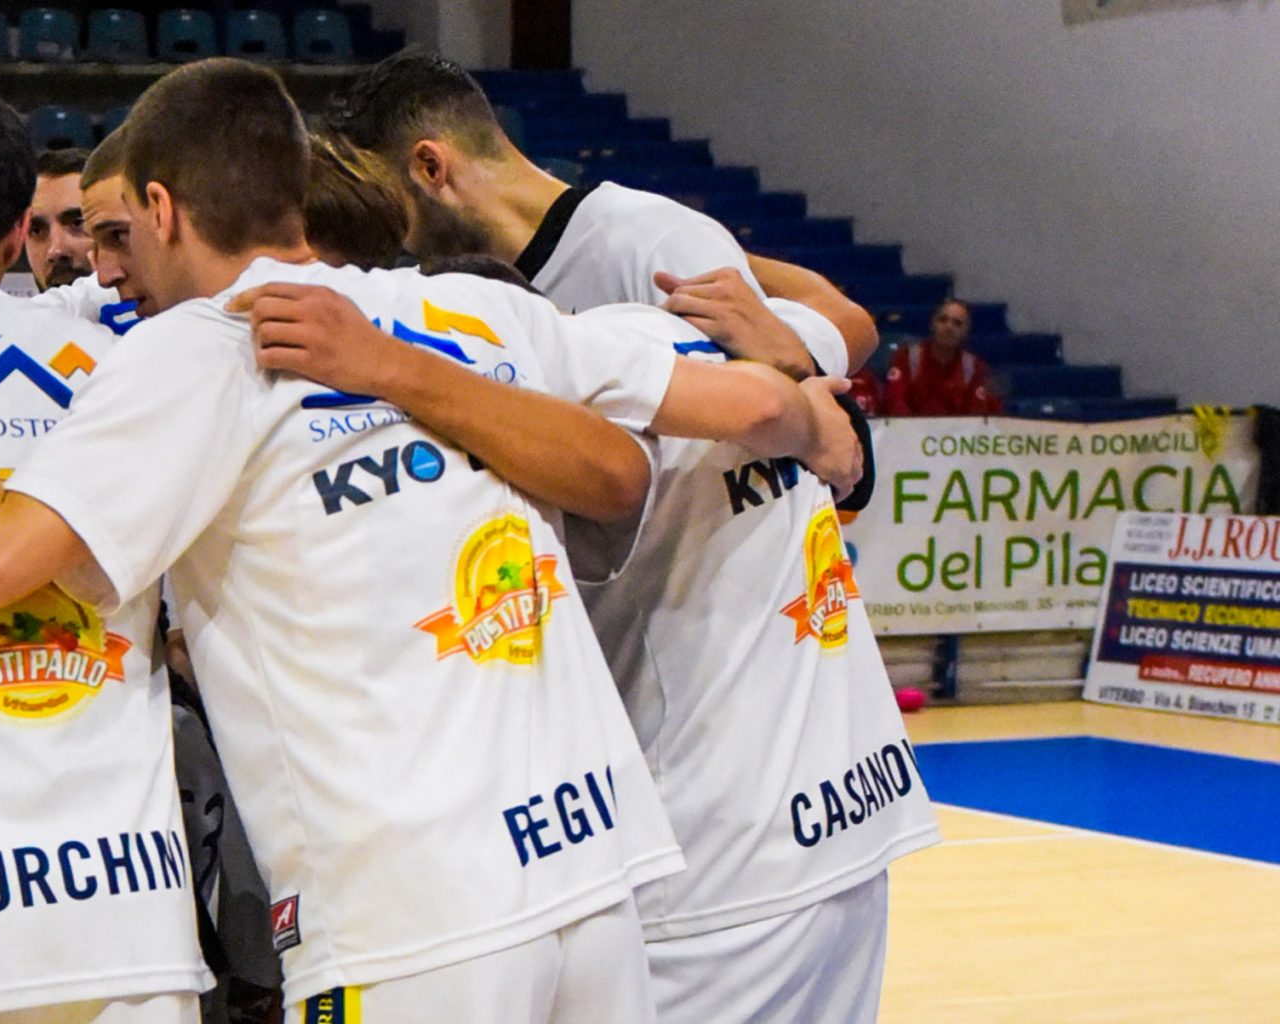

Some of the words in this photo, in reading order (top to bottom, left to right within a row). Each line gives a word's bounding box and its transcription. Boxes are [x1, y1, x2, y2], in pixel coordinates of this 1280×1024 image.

[922, 434, 1058, 457] CONSEGNE
[1066, 434, 1083, 454] A
[893, 464, 1242, 524] FARMACIA
[1168, 516, 1215, 561] J.J.
[896, 534, 982, 593] del
[1130, 571, 1178, 593] LICEO
[1119, 625, 1168, 648] LICEO
[1170, 629, 1242, 655] SCIENZE
[29, 649, 108, 687] PAOLO
[502, 764, 618, 868] REGI
